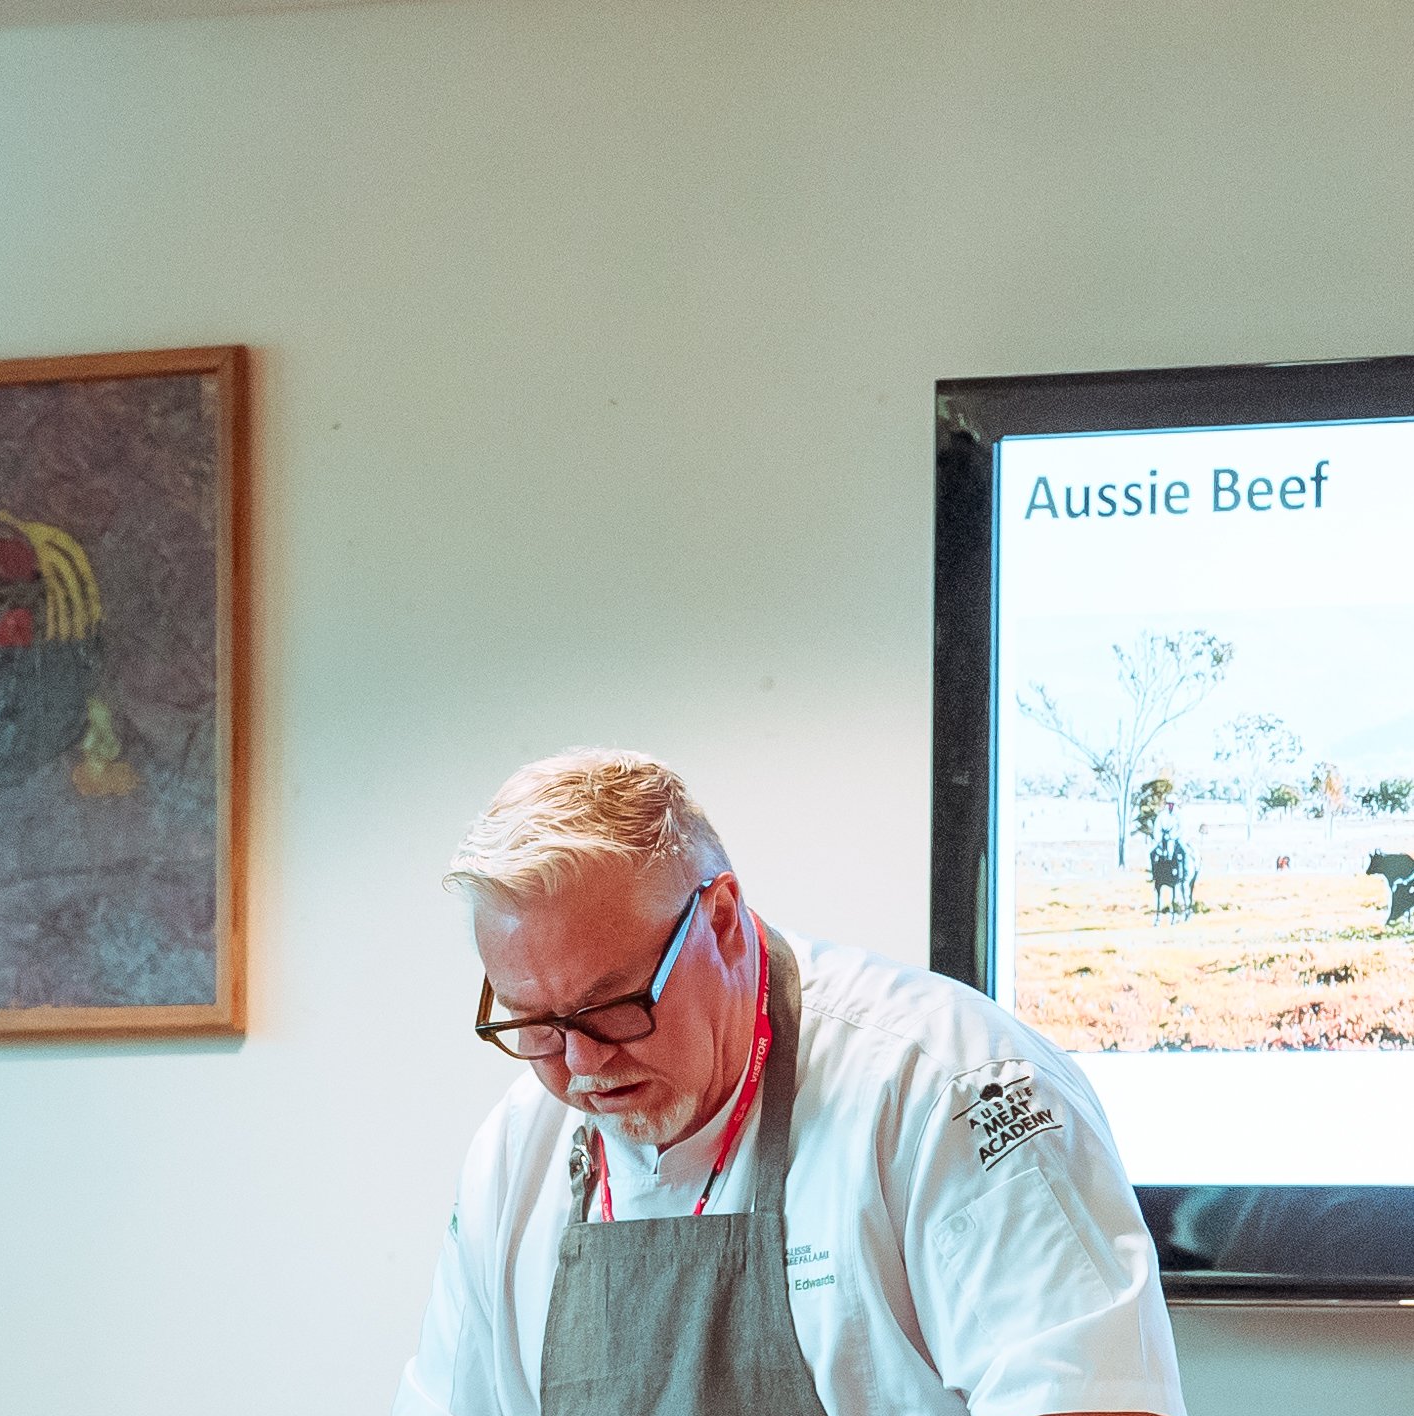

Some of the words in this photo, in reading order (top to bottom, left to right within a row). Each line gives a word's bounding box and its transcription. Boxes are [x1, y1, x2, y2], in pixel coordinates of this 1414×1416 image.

[1024, 469, 1190, 520] Aussie
[1212, 459, 1331, 513] Beef
[750, 1037, 769, 1084] VISITOR
[969, 1086, 1034, 1130] AUSSIE
[982, 1100, 1032, 1138] MEAT
[978, 1109, 1055, 1166] ACADEMY
[794, 1274, 836, 1291] Edwards
